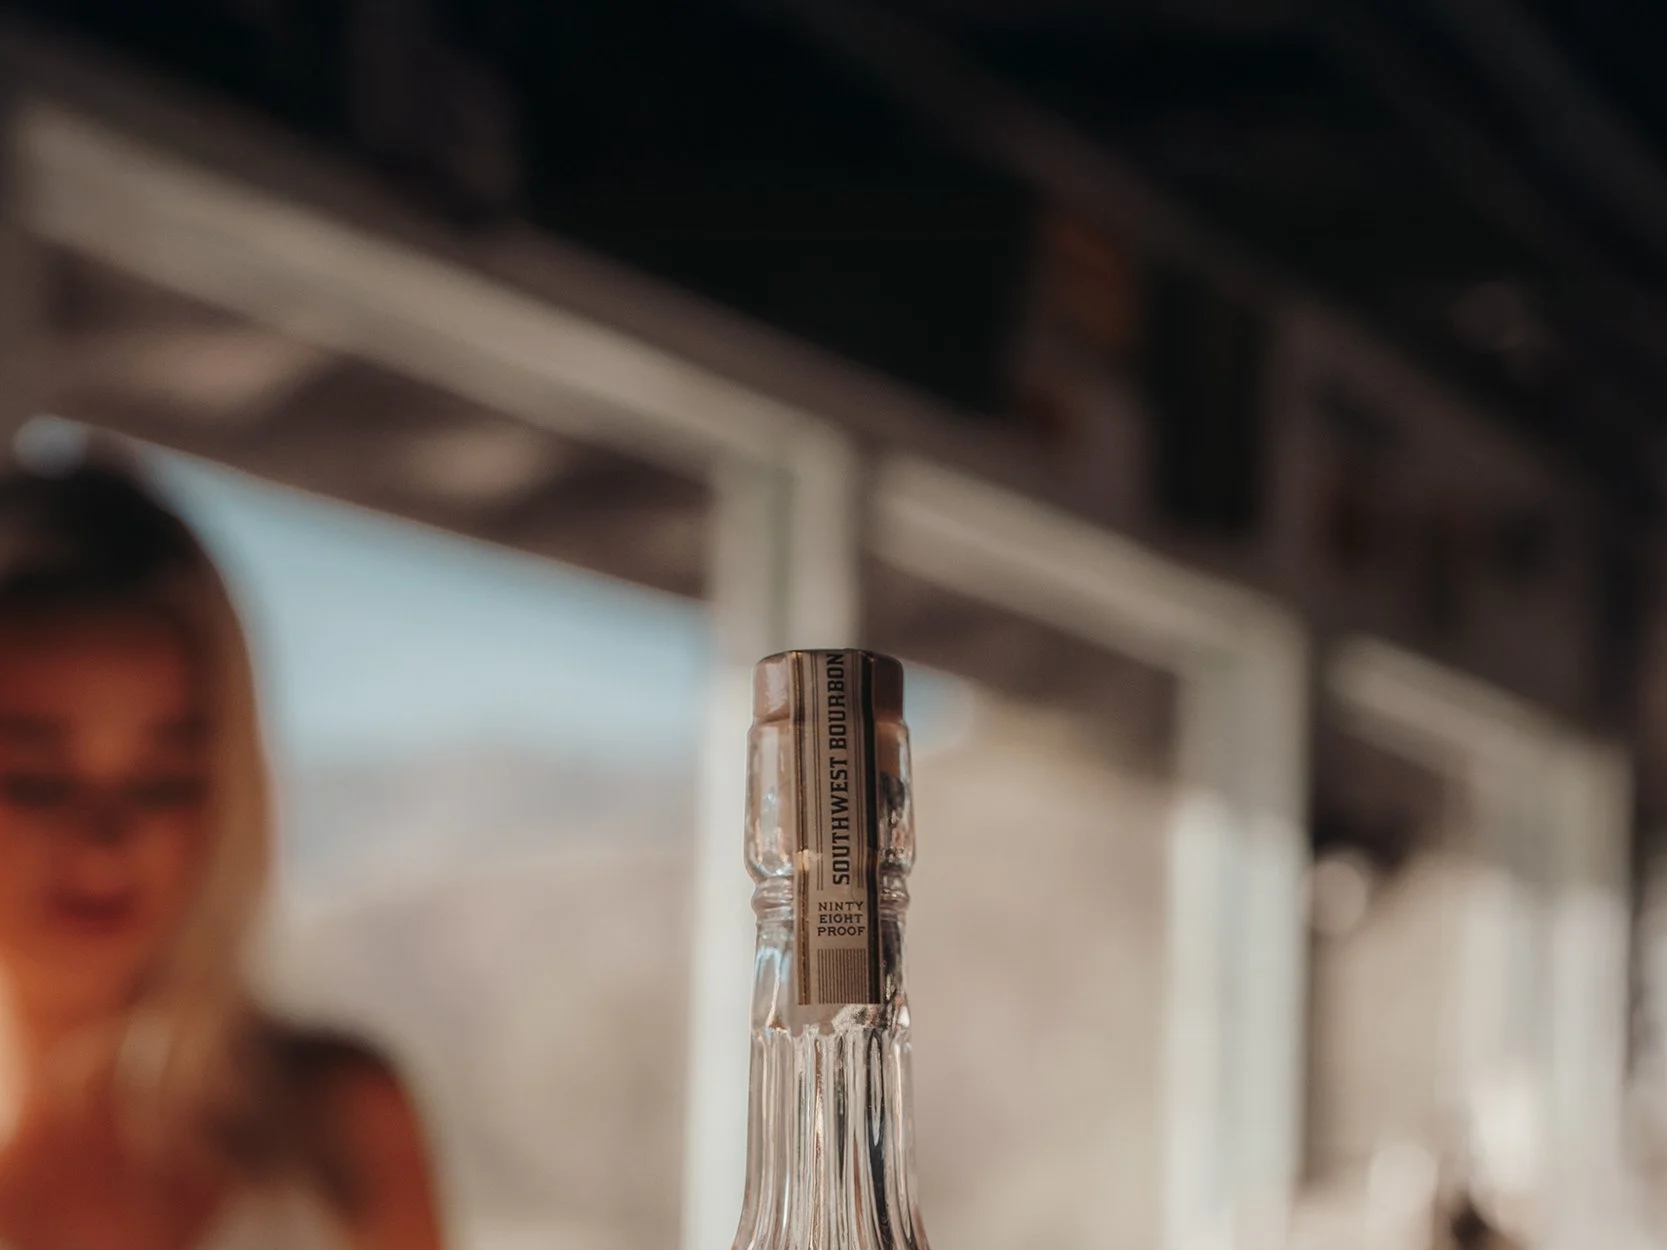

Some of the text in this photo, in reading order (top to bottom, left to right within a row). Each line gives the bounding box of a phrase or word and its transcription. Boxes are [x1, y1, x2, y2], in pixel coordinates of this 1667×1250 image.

[826, 653, 850, 885] SOUTHWEST BOURBON
[817, 901, 864, 912] NINTY
[819, 914, 863, 924] EIGHT
[817, 926, 866, 937] PROOF
